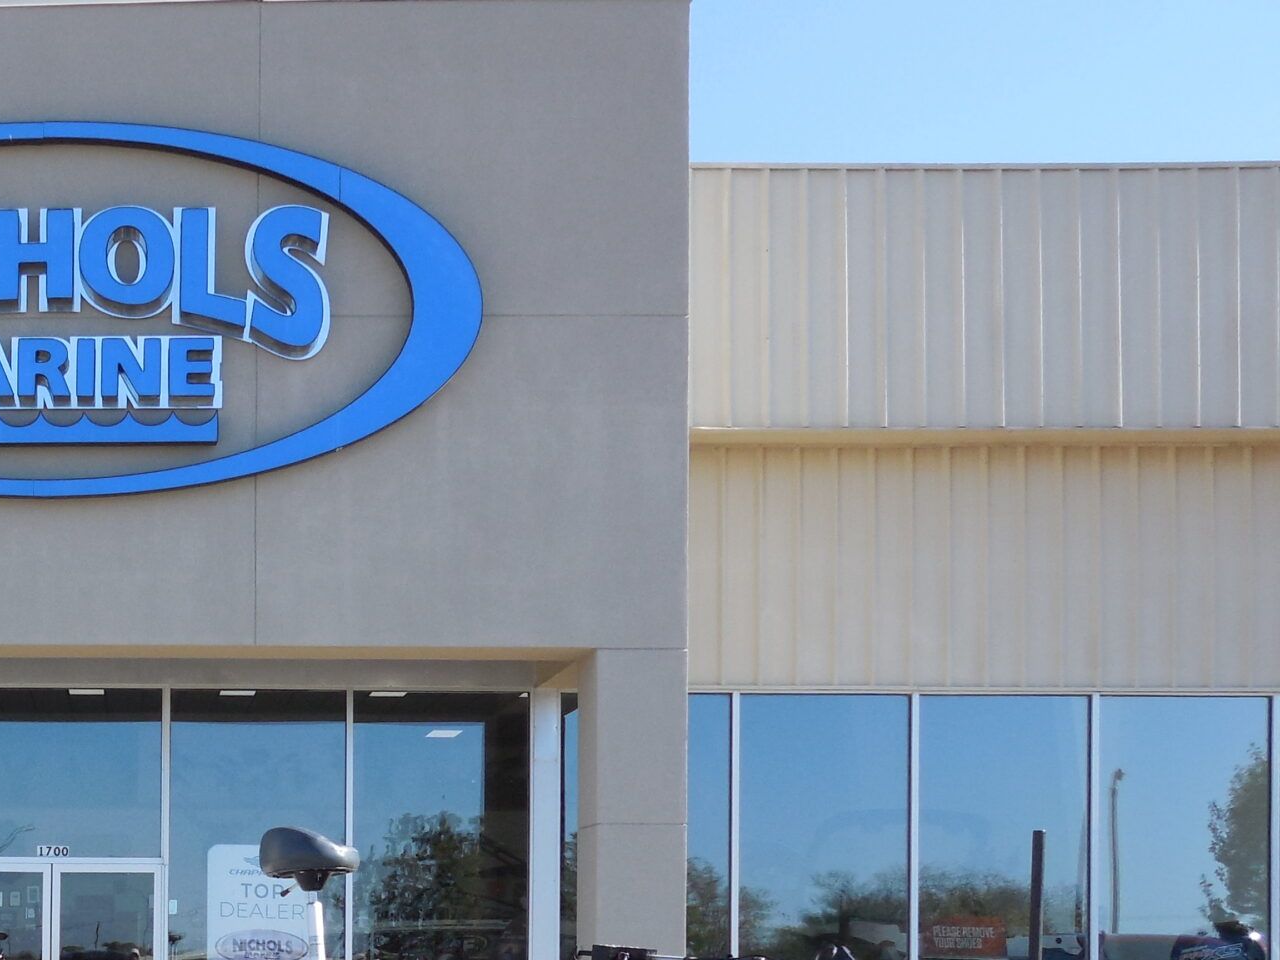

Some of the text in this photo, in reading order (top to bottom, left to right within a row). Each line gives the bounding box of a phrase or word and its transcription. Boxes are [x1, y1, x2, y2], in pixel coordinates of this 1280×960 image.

[38, 846, 69, 857] 1700
[241, 883, 284, 899] TOP
[220, 901, 305, 920] DEALER
[932, 925, 995, 938] PLEASE REMOVE
[232, 938, 293, 954] NICHOLS
